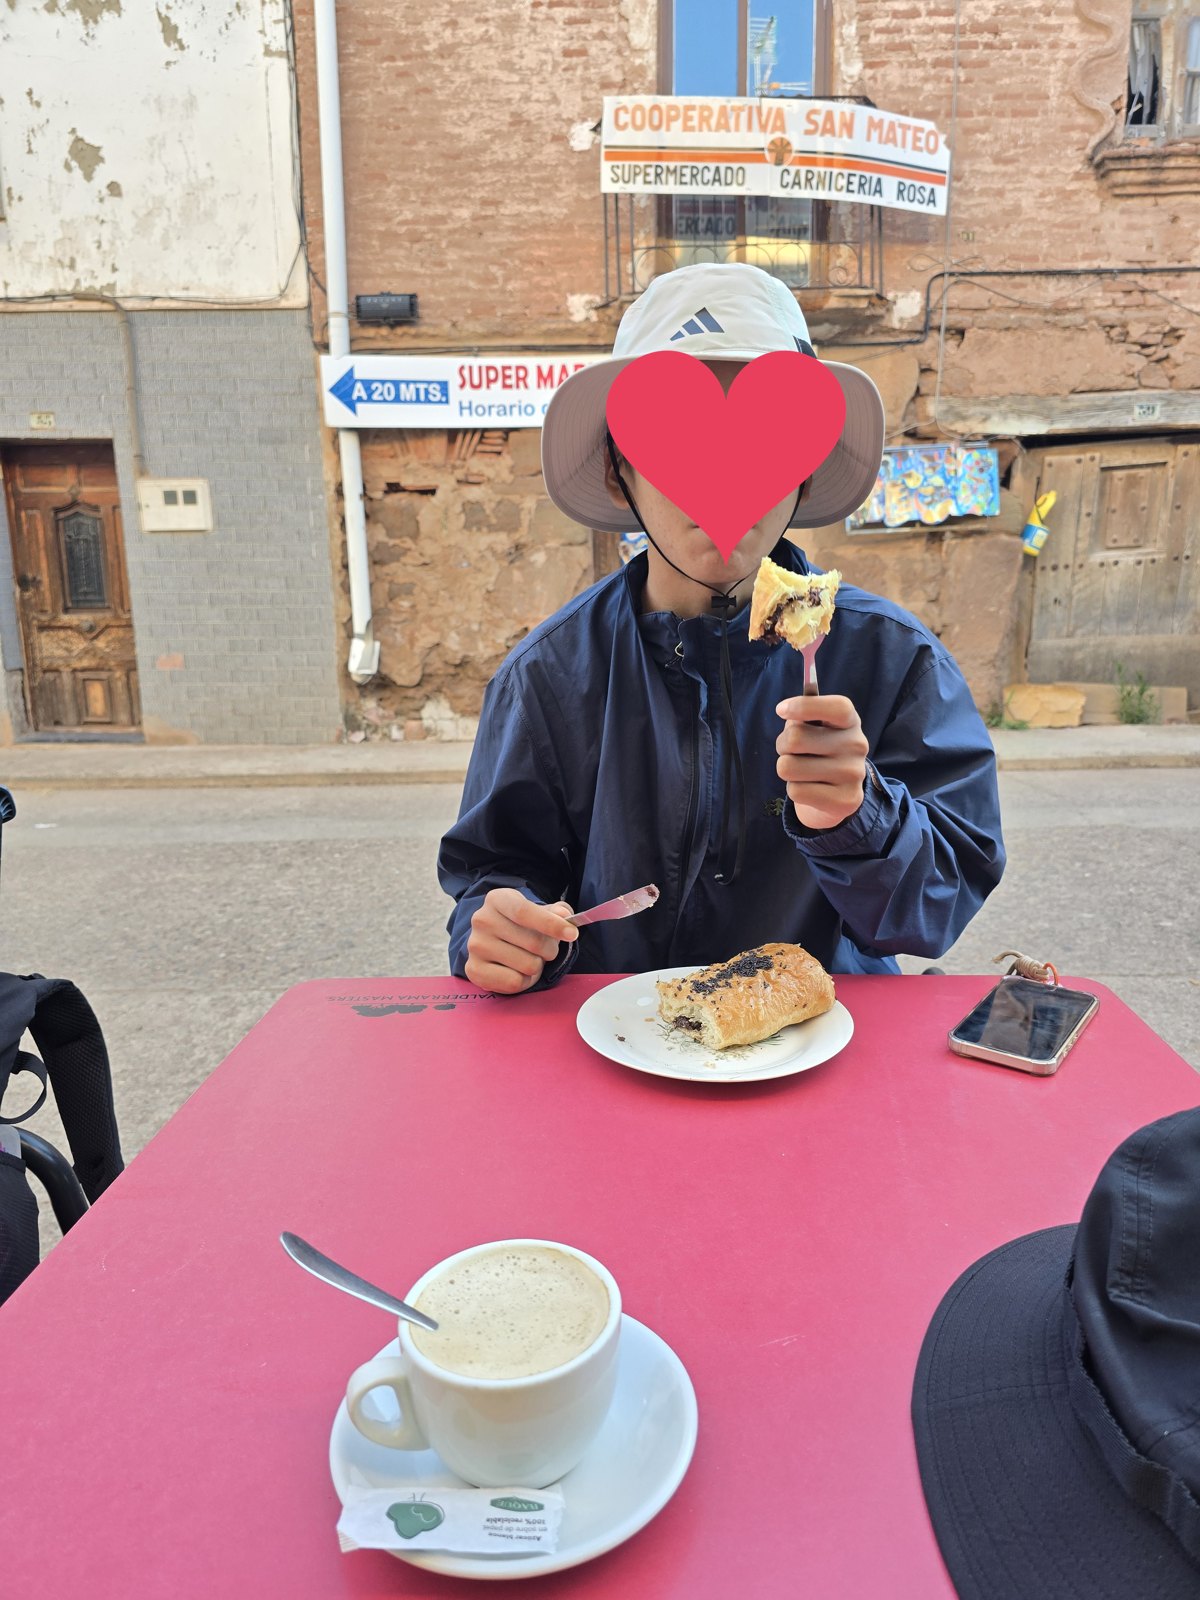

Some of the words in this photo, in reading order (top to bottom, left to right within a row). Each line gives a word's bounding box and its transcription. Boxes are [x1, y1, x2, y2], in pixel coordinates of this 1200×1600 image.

[613, 104, 788, 135] COOPERATIVA
[803, 108, 856, 139] SAN
[866, 115, 940, 156] MATEO
[610, 164, 746, 187] SUPERMERCADO
[779, 168, 884, 199] CARNICERIA
[896, 182, 937, 208] ROSA
[457, 364, 529, 390] SUPER
[535, 364, 586, 389] MA
[351, 383, 368, 401] A
[371, 383, 396, 401] 20
[400, 383, 447, 402] MTS.
[458, 400, 536, 417] Horario
